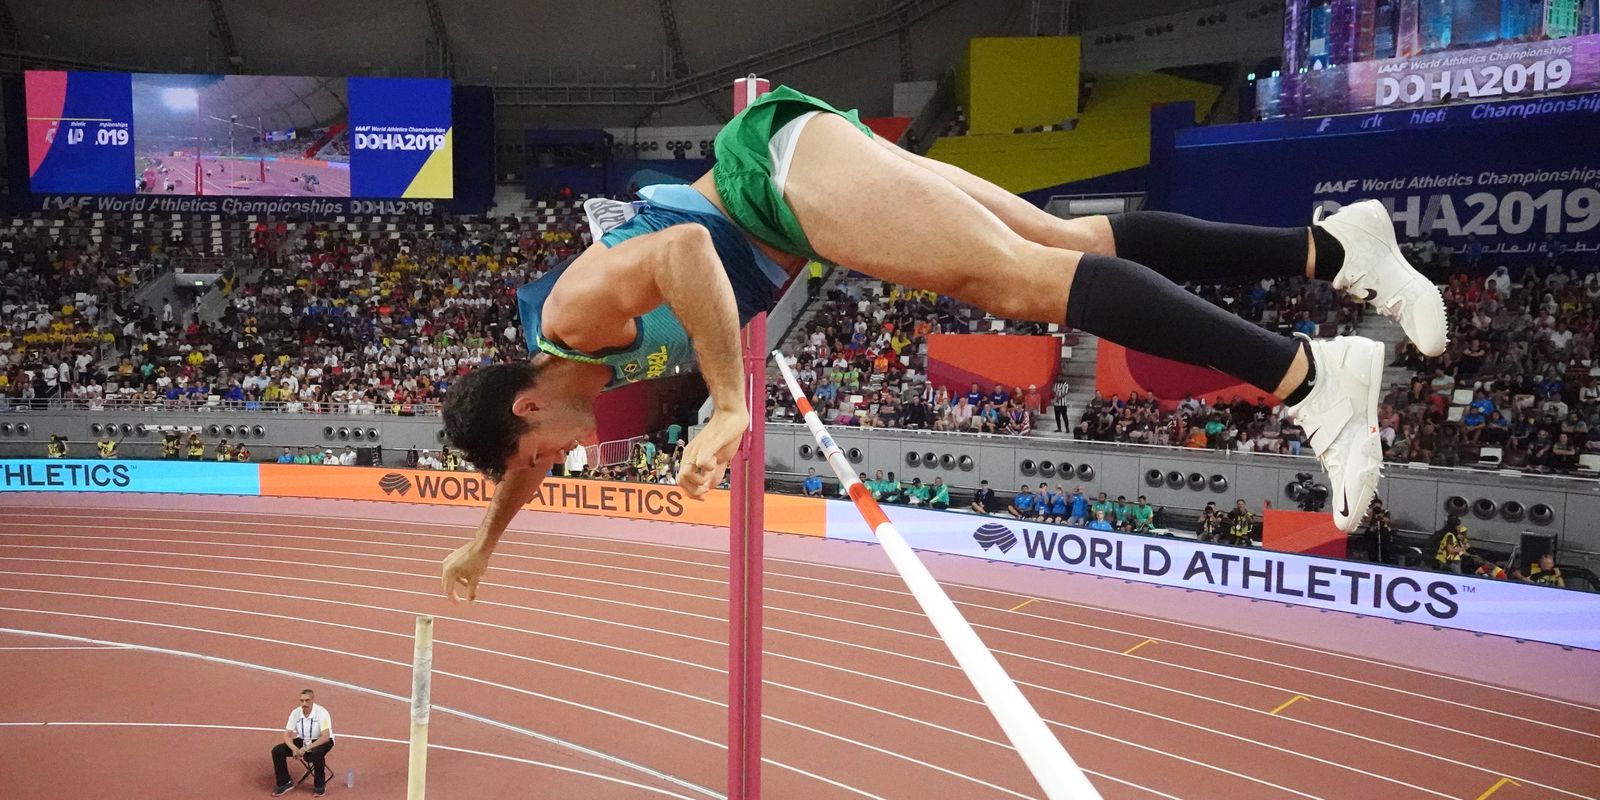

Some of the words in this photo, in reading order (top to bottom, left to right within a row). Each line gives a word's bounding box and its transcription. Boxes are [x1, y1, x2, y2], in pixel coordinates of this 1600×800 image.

[1378, 62, 1407, 74] IAAF
[1410, 59, 1441, 71] World
[1443, 54, 1487, 67] Athletics
[1489, 44, 1573, 62] Championships
[1376, 58, 1572, 106] DOHA2019
[1471, 91, 1600, 119] Championship
[355, 133, 446, 150] DOHA2019
[1314, 179, 1358, 194] IAAF
[1362, 176, 1405, 191] World
[1407, 172, 1473, 190] Athletics
[98, 197, 145, 212] World
[149, 198, 217, 213] Athletics
[1312, 187, 1600, 238] HA2019
[0, 464, 130, 487] HLETICS
[415, 475, 493, 502] WORL
[1023, 528, 1171, 577] WORLD
[1182, 550, 1459, 619] ATHLETICS
